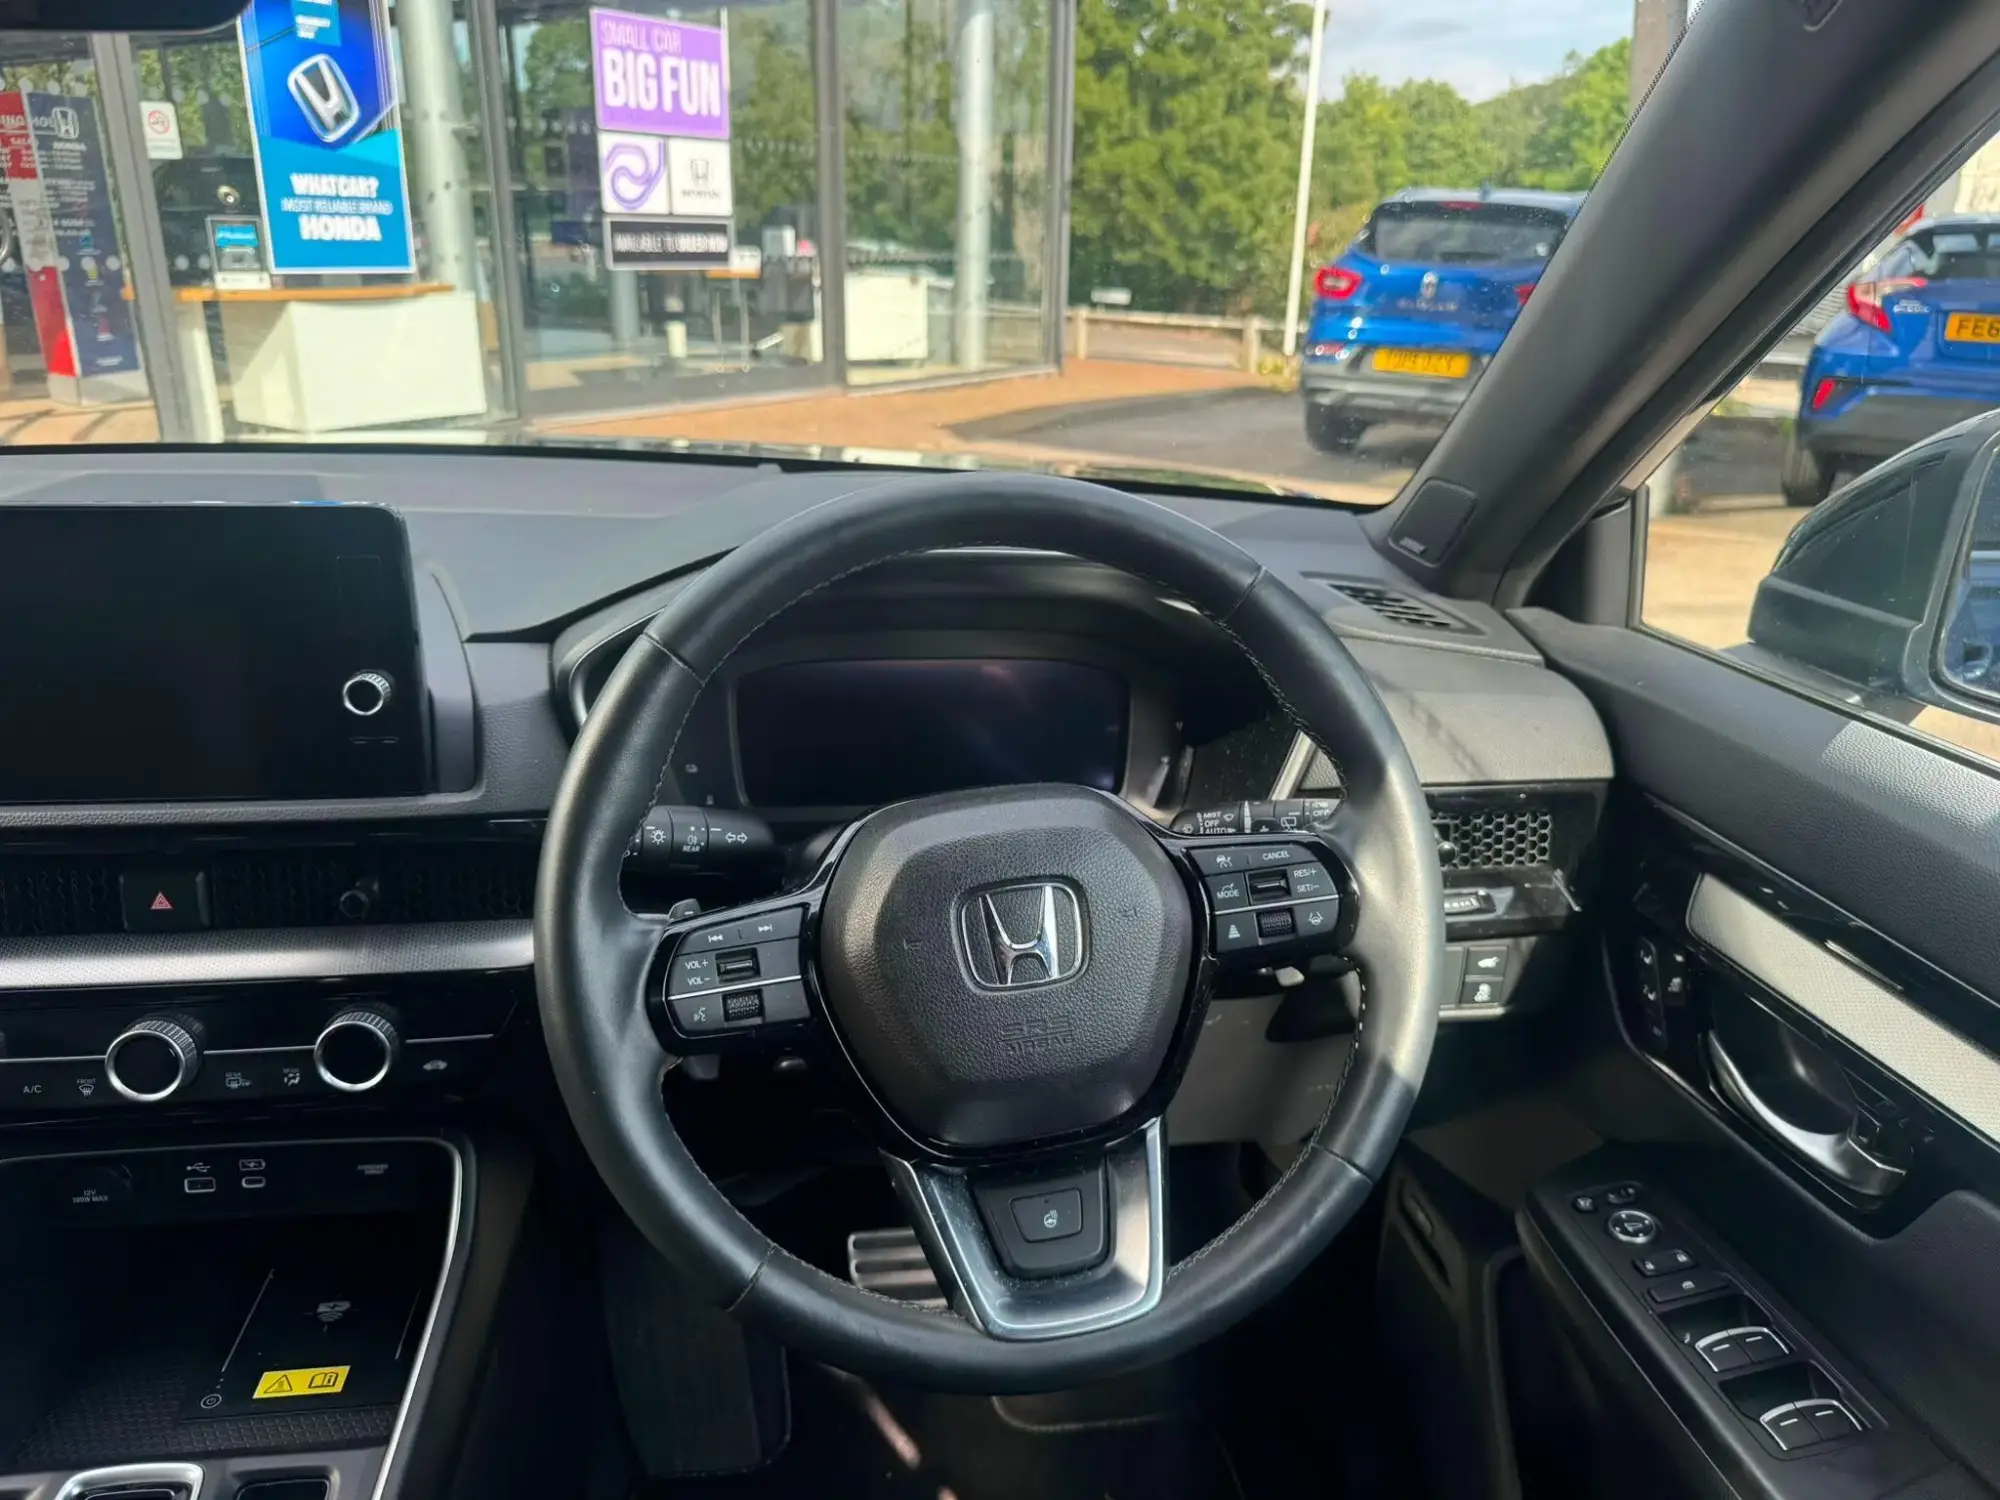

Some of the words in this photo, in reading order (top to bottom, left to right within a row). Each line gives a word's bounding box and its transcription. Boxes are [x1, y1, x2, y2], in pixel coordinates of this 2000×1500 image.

[601, 20, 648, 50] SMALL
[653, 29, 682, 53] CAR
[603, 48, 658, 110] BIG
[661, 56, 721, 117] FUN
[298, 213, 382, 241] HONDA
[1203, 811, 1222, 819] MIST
[1204, 819, 1220, 828] OFF
[1262, 850, 1290, 861] CANCEL
[1216, 889, 1240, 899] MODE
[23, 1085, 42, 1094] A/C
